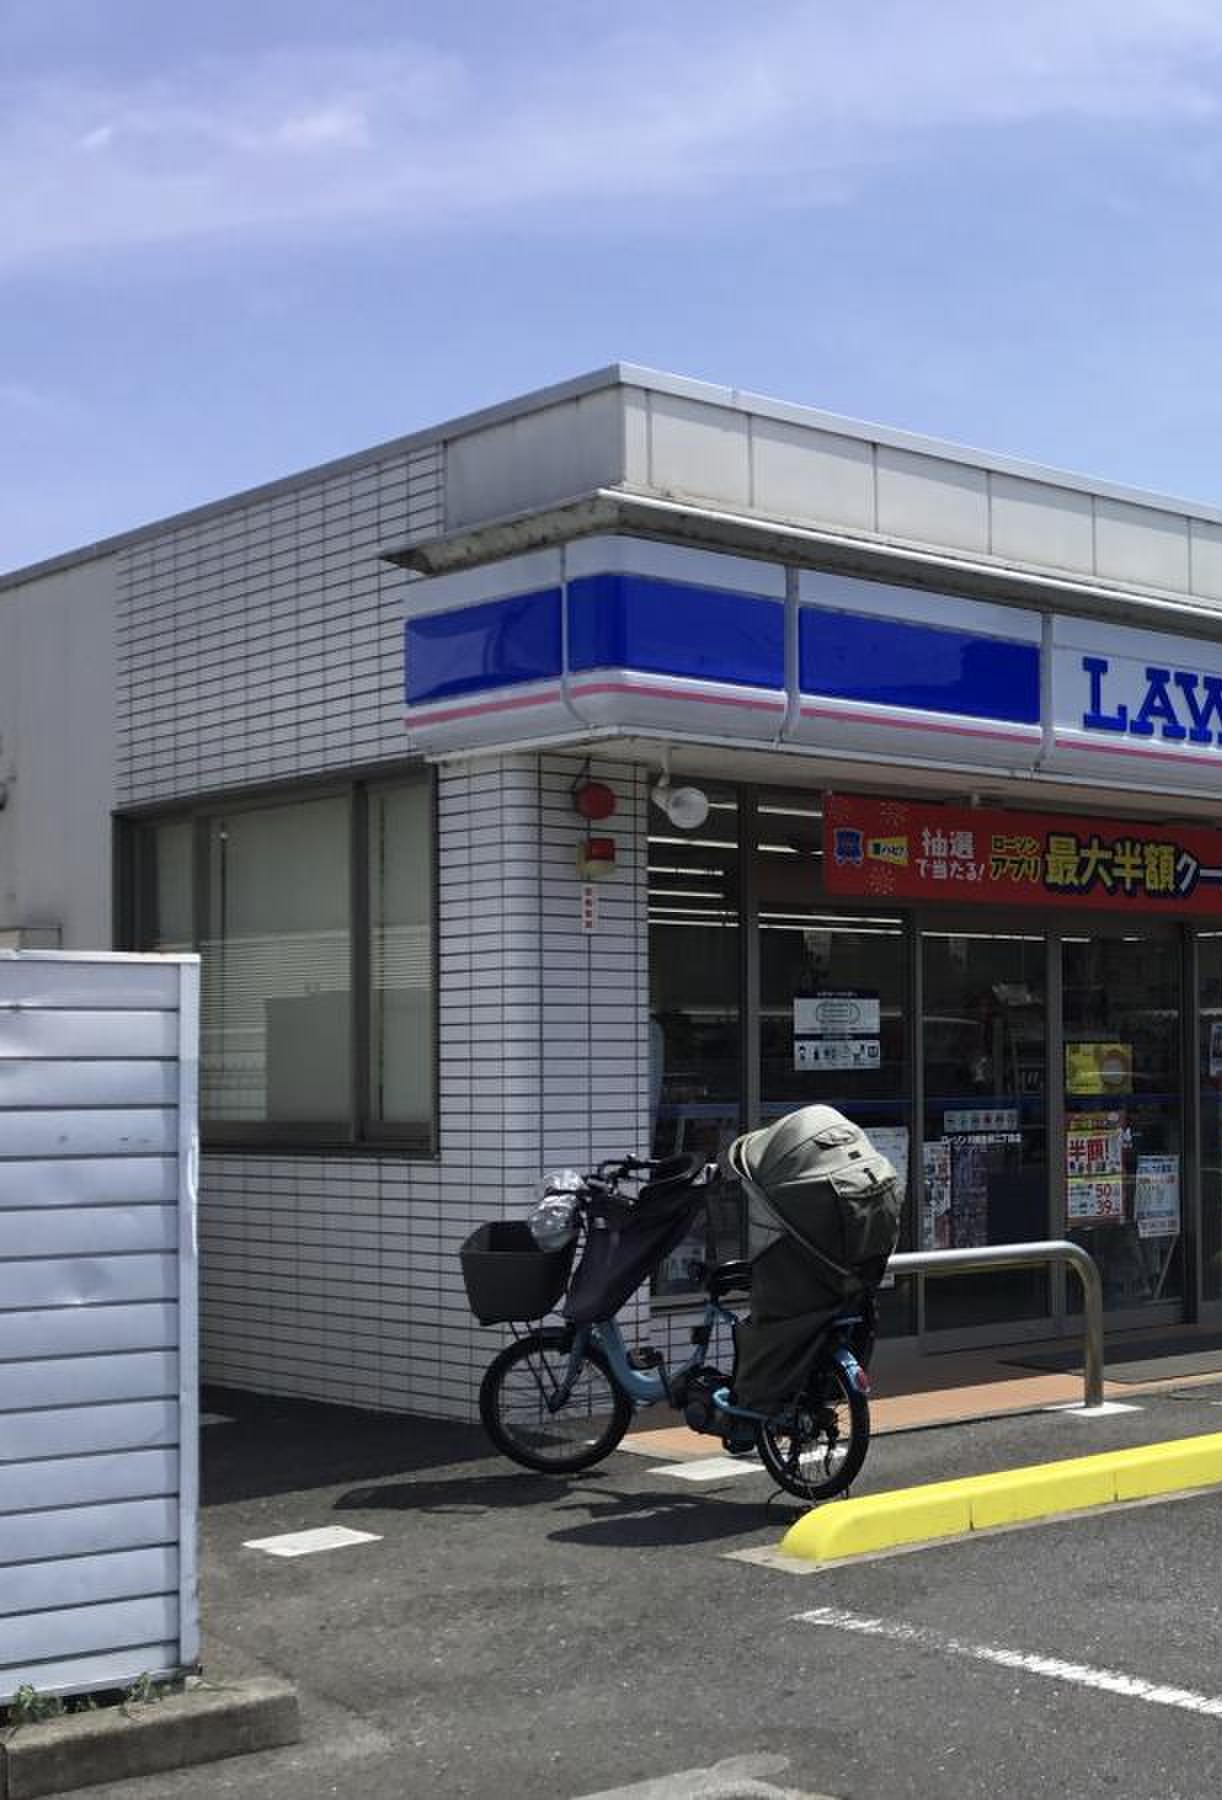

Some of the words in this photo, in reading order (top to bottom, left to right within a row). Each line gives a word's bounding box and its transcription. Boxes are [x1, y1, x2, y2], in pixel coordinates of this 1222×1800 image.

[921, 827, 974, 859] 抽選
[990, 857, 1041, 881] アプリ
